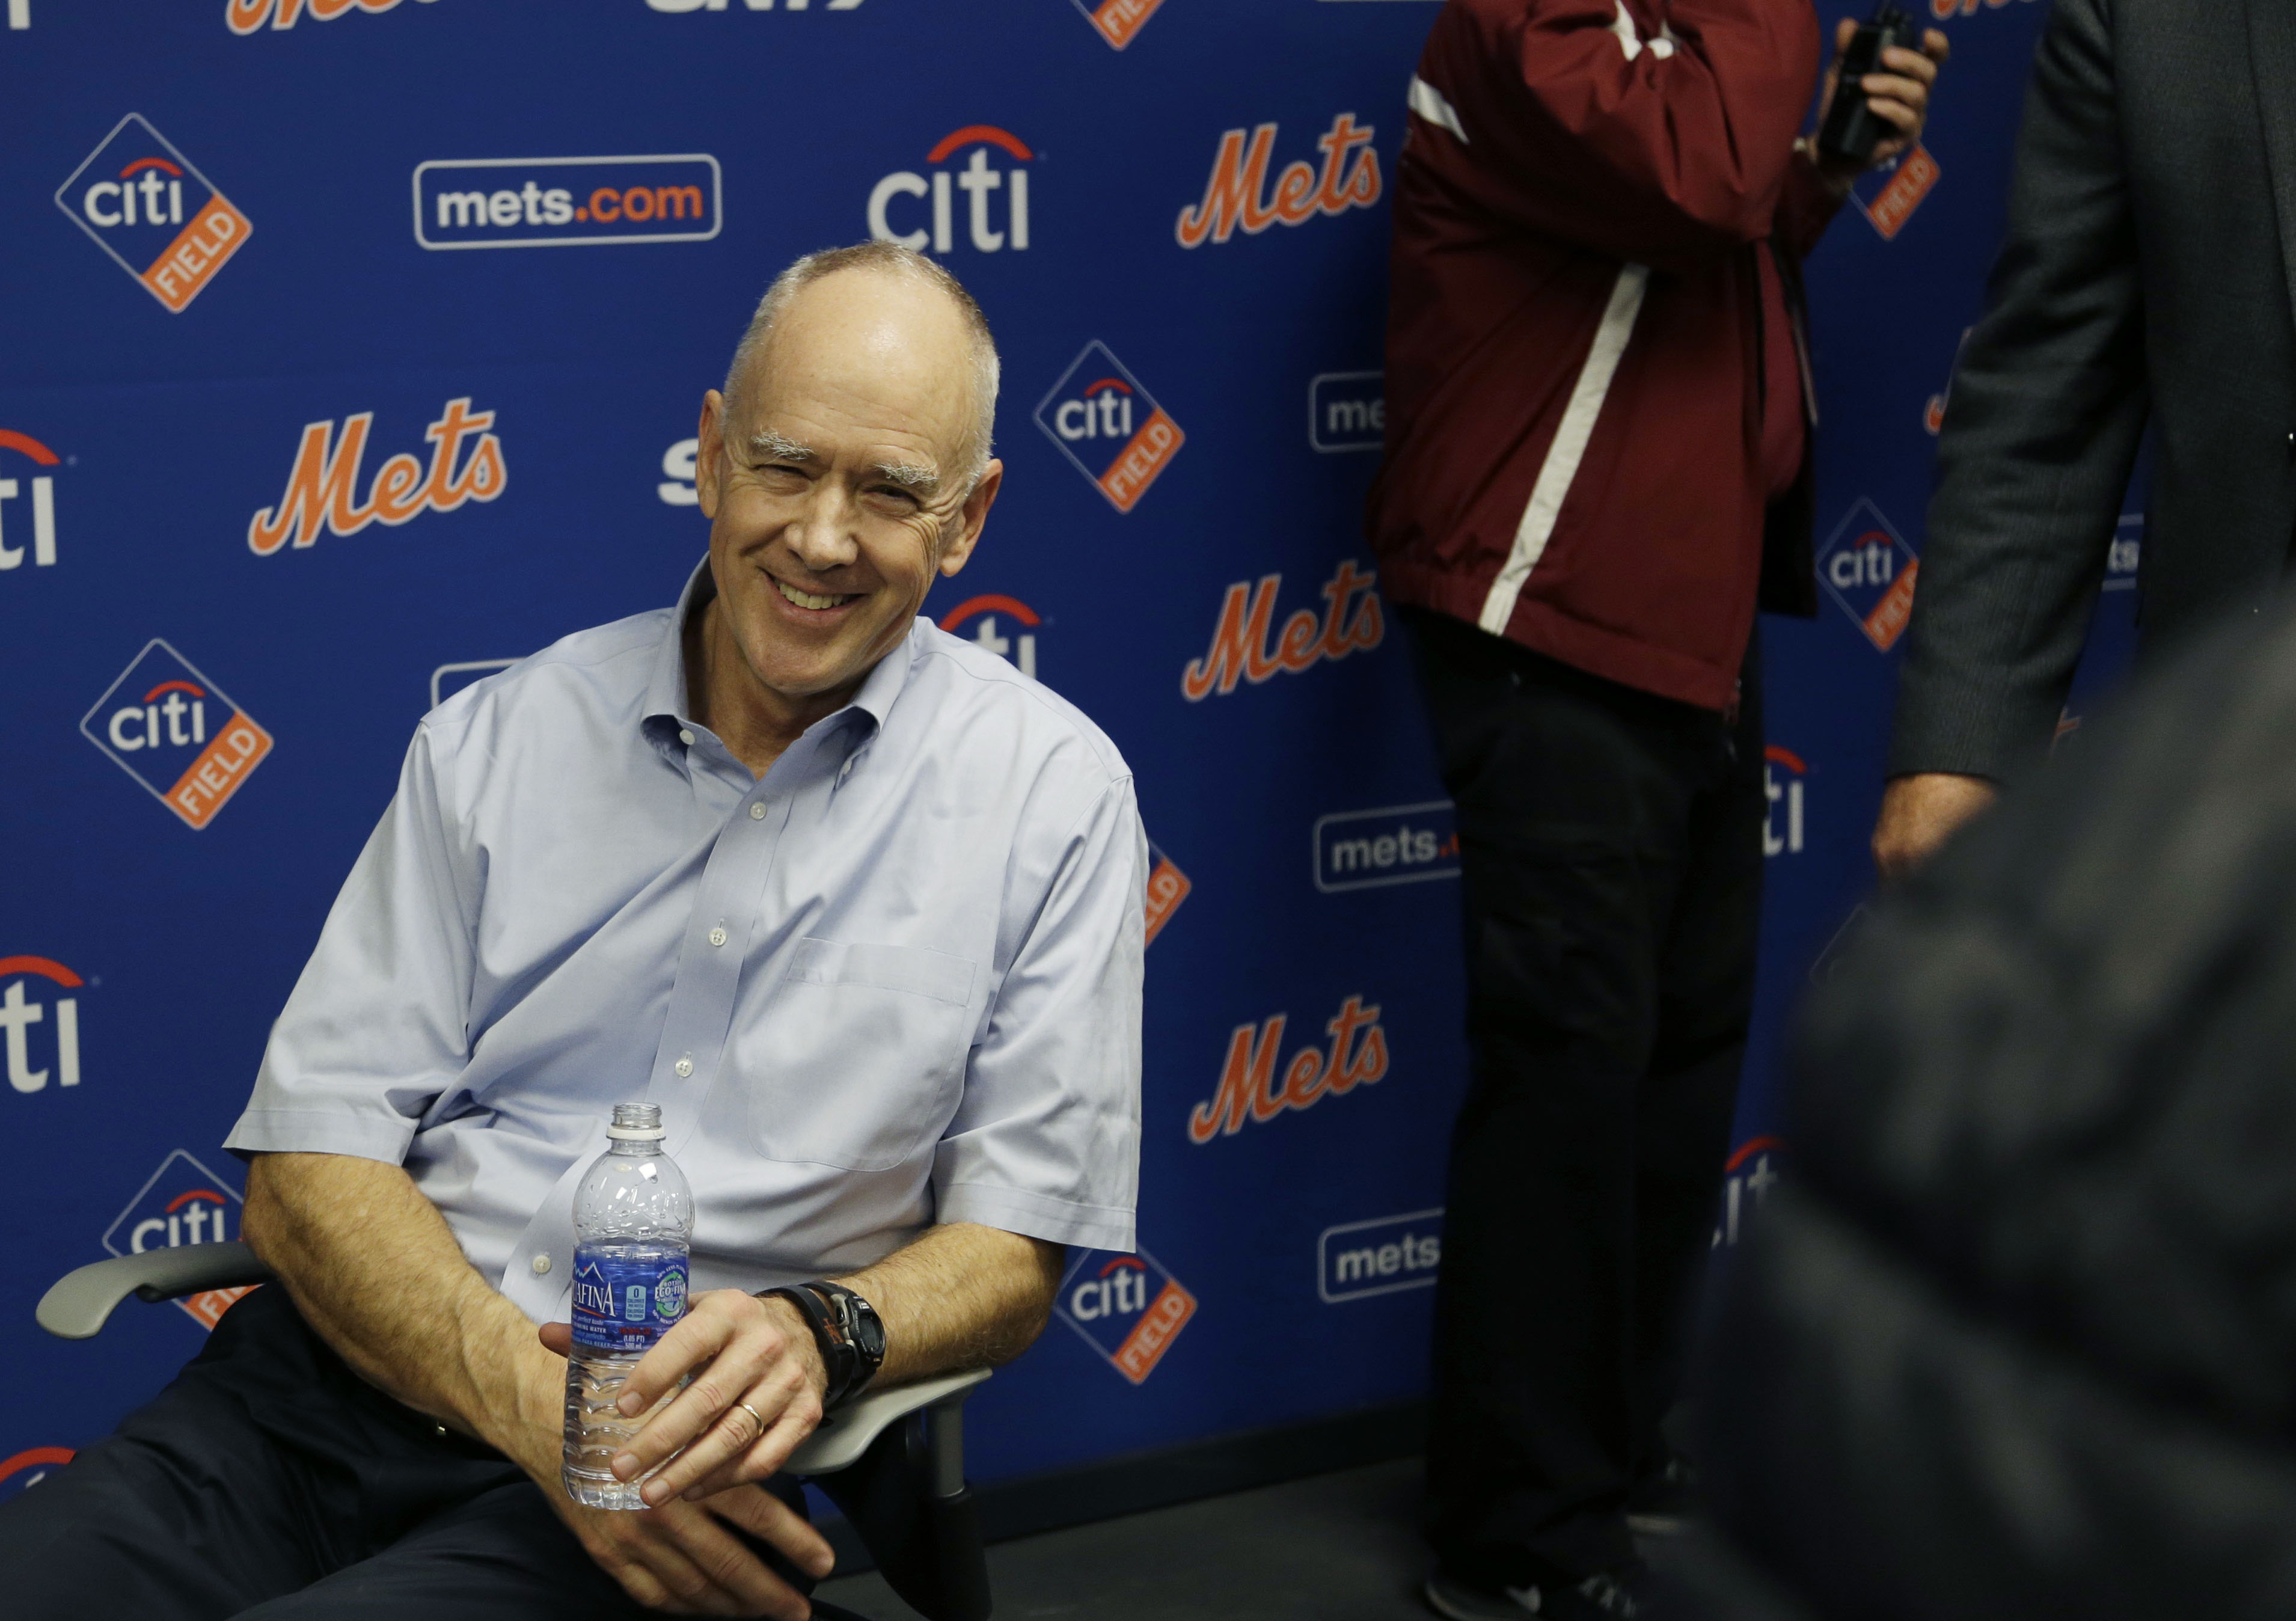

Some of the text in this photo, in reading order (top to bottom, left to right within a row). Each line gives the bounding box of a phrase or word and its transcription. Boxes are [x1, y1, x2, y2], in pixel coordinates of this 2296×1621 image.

[84, 170, 183, 227] citi
[437, 181, 703, 227] mets.com
[867, 148, 1029, 253] citi
[1175, 113, 1382, 249] Mets
[155, 211, 236, 298] FIELD
[1055, 390, 1131, 441] citi
[247, 397, 507, 556] Mets
[1107, 423, 1173, 501] FIELD
[1828, 541, 1893, 589] citi
[1181, 559, 1384, 702] Mets
[109, 692, 205, 752] citi
[177, 728, 257, 816] FIELD
[1188, 994, 1389, 1143] Mets
[131, 1201, 224, 1254] citi
[1336, 1232, 1442, 1282] mets
[634, 1288, 639, 1298] 0
[1071, 1266, 1146, 1321] citi
[1125, 1294, 1186, 1373] FIELD
